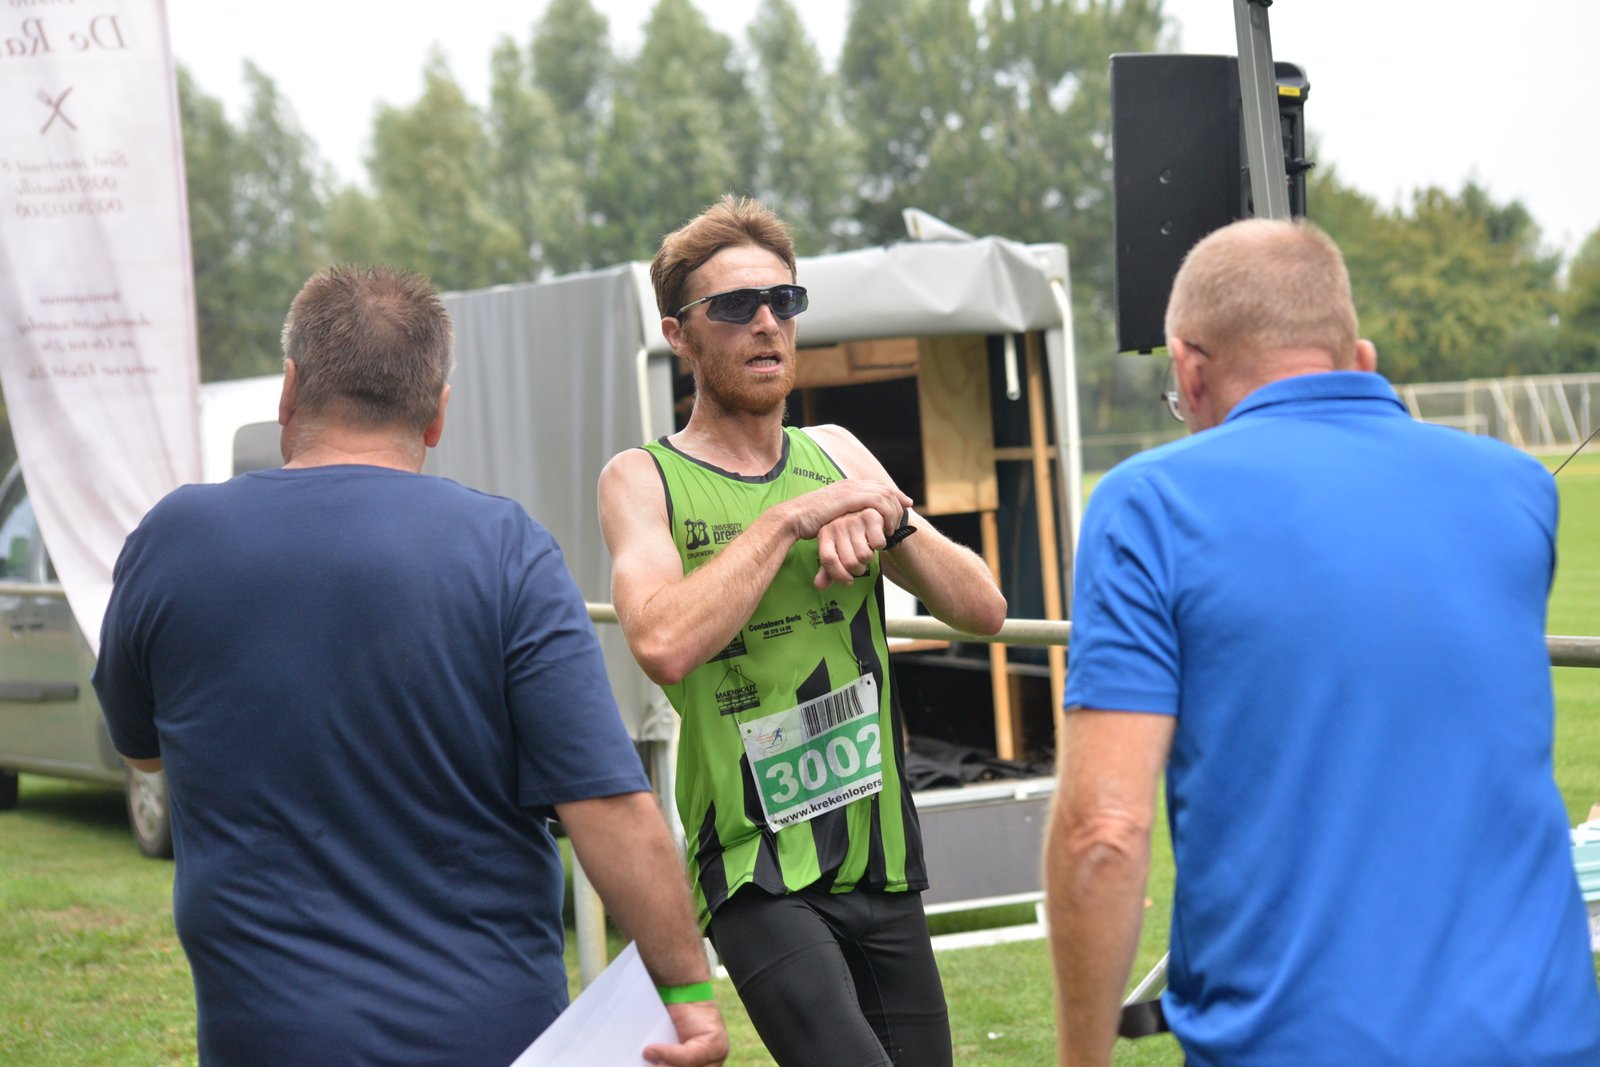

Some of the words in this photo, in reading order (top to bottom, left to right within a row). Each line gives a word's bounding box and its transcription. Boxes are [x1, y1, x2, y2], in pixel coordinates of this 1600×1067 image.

[793, 467, 836, 485] BIORACE
[712, 523, 742, 531] UNIVERSITY
[749, 619, 784, 632] Containers
[716, 685, 757, 699] MAENHOUT
[765, 723, 882, 804] 3002
[779, 778, 882, 825] www.krekenlopers
